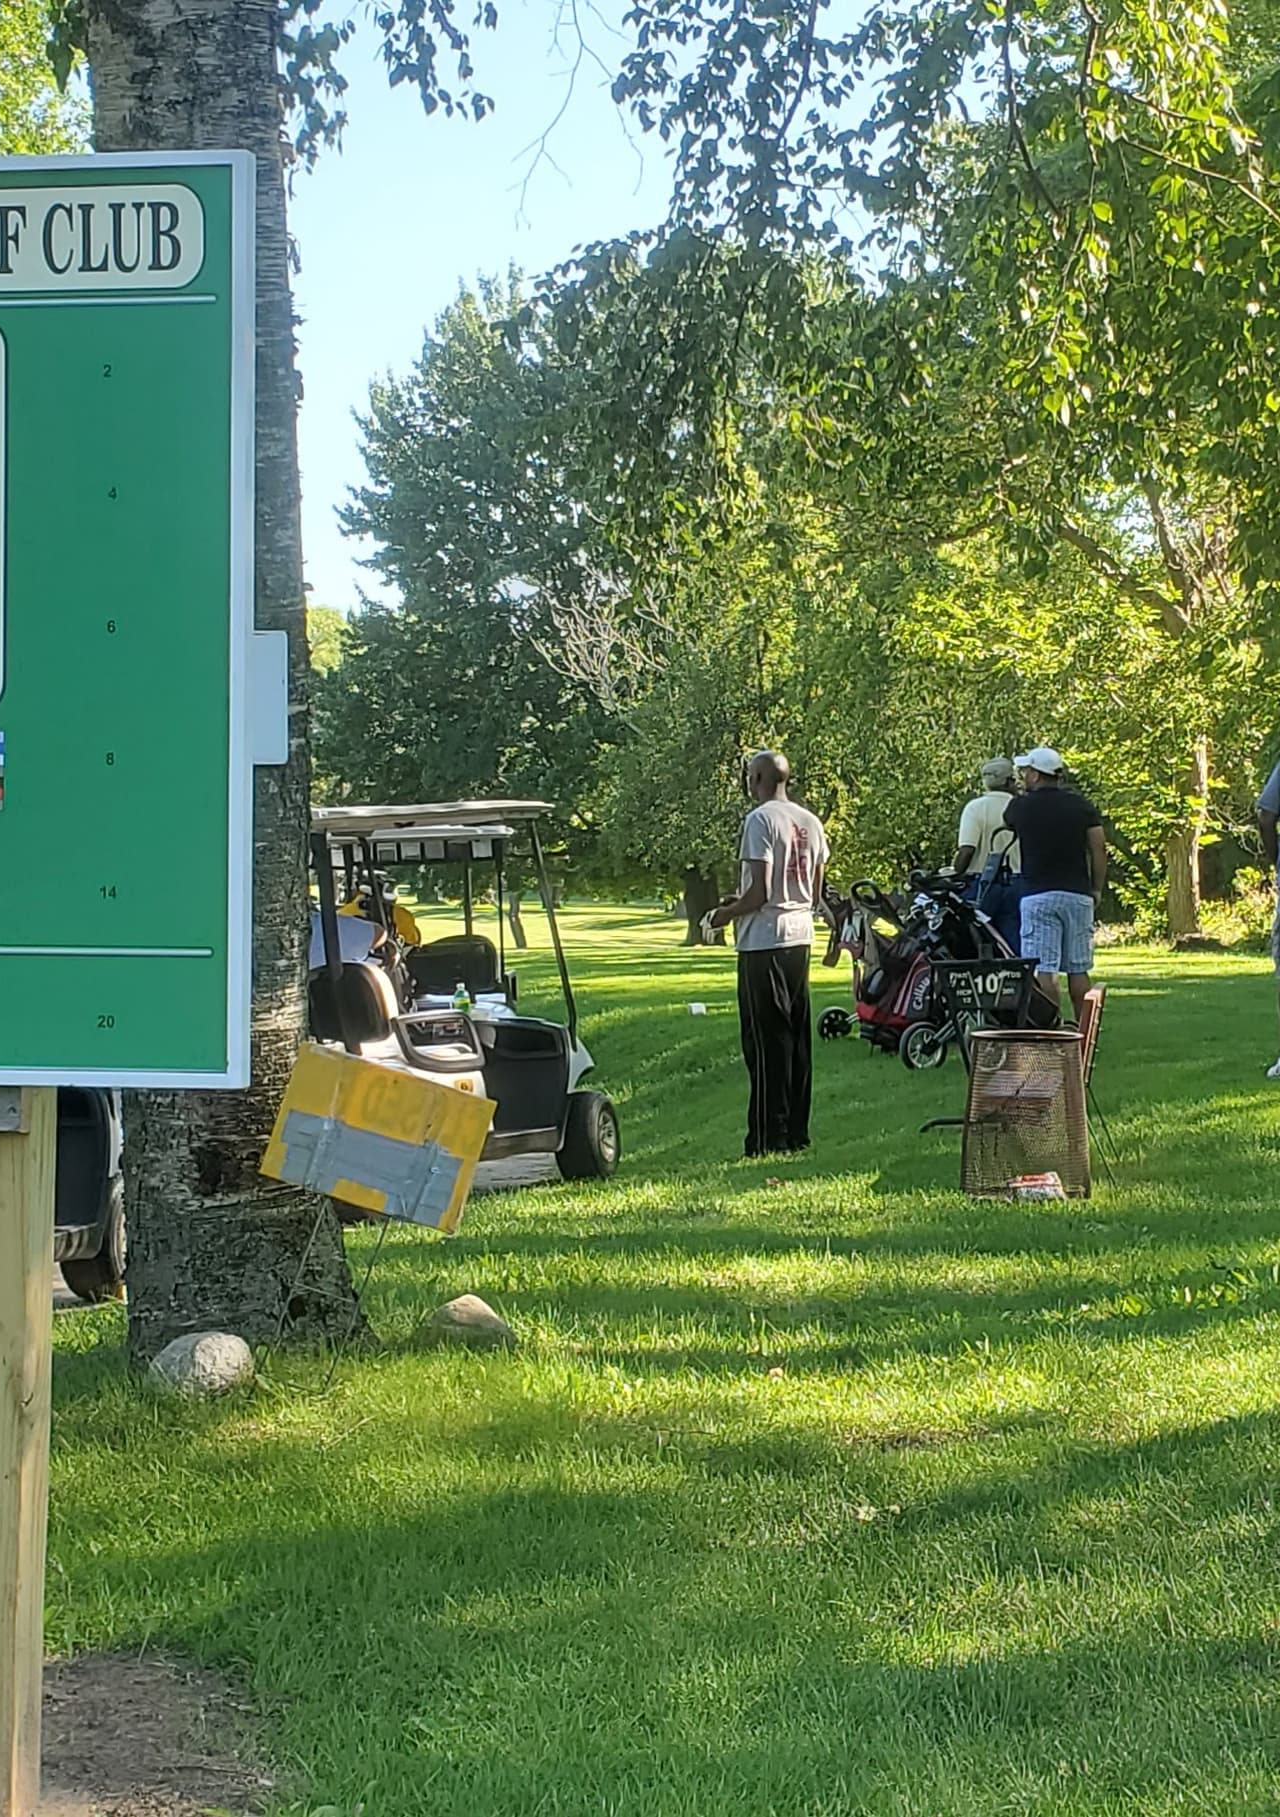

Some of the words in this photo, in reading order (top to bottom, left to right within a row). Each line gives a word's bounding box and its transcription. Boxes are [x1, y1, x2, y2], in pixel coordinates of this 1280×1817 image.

[43, 202, 181, 274] CLUB
[104, 365, 111, 377] 2
[108, 487, 116, 499] 4
[107, 620, 115, 633] 6
[100, 886, 116, 898] 14
[974, 973, 998, 994] 10
[98, 1015, 114, 1028] 20
